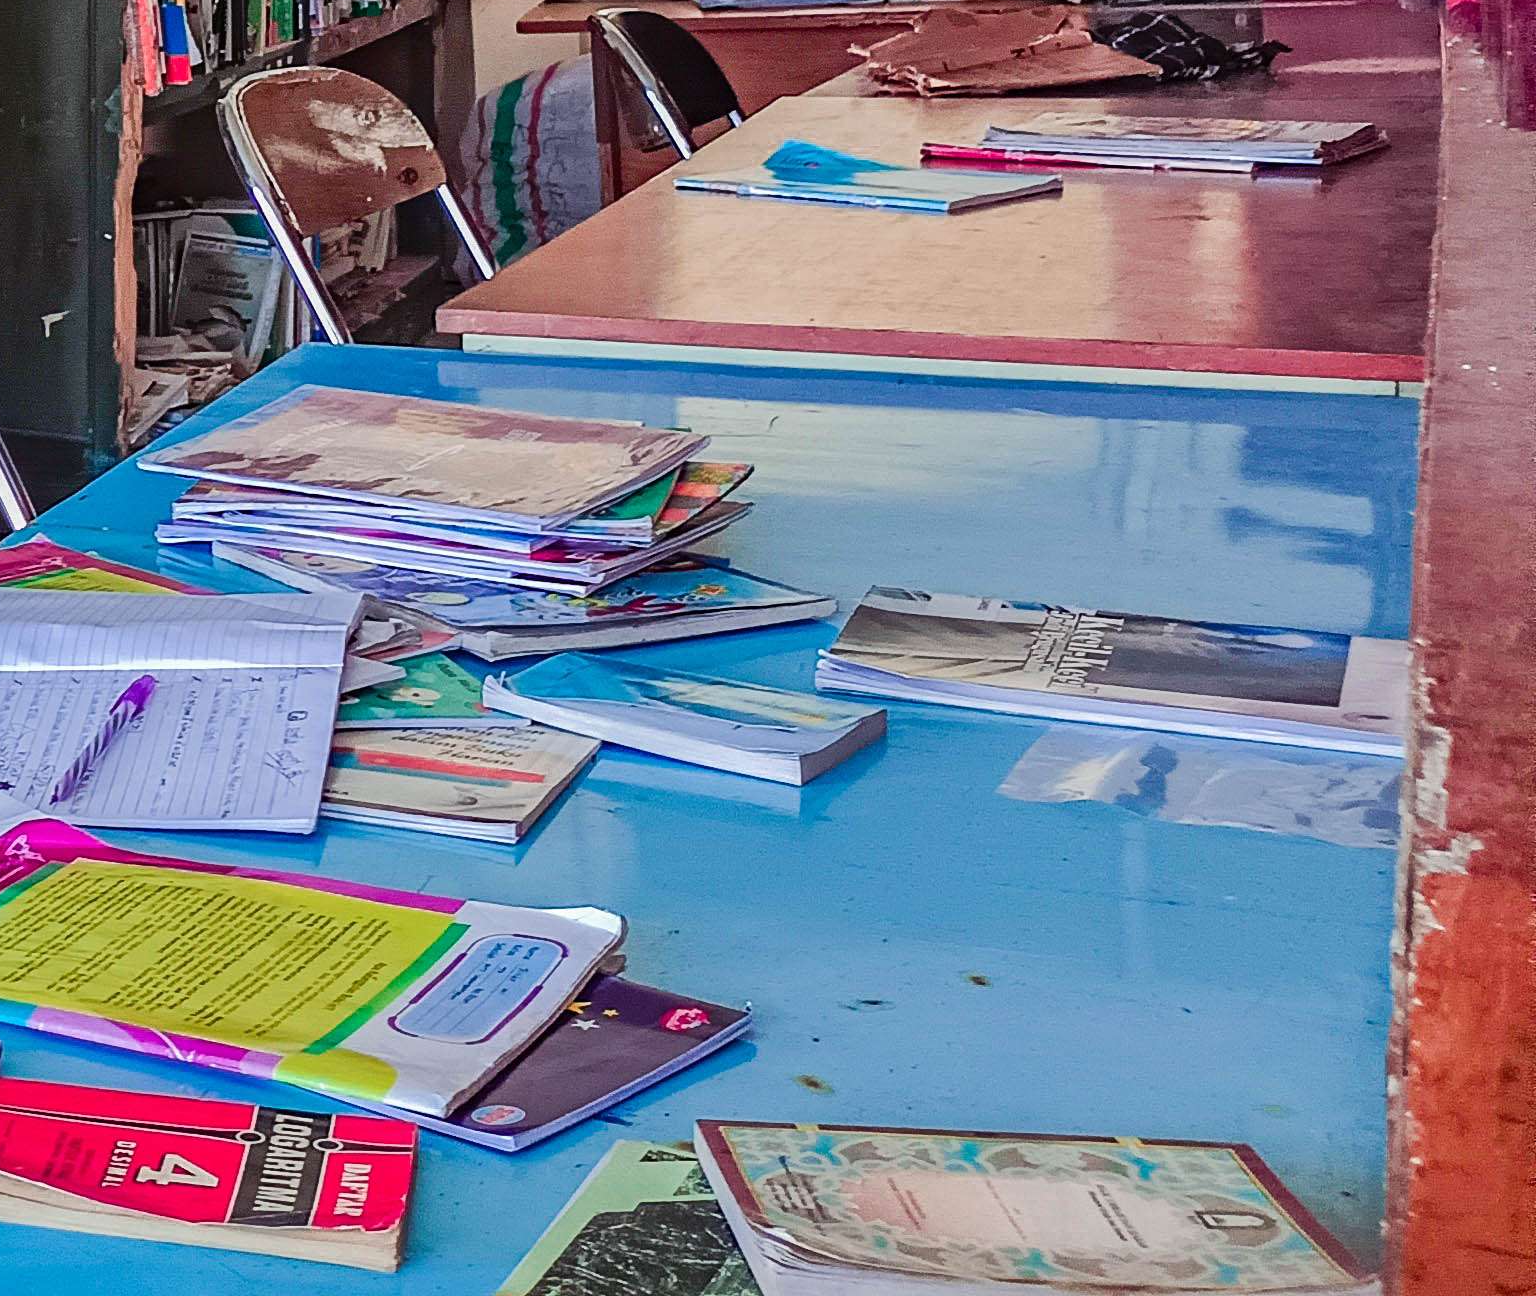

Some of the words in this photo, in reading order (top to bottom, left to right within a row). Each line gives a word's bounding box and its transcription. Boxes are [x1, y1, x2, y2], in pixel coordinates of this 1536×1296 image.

[101, 1140, 137, 1188] DESIMAL
[135, 1152, 219, 1188] 4
[254, 1114, 314, 1212] LOGARITMA
[333, 1162, 372, 1217] DAFTAR
